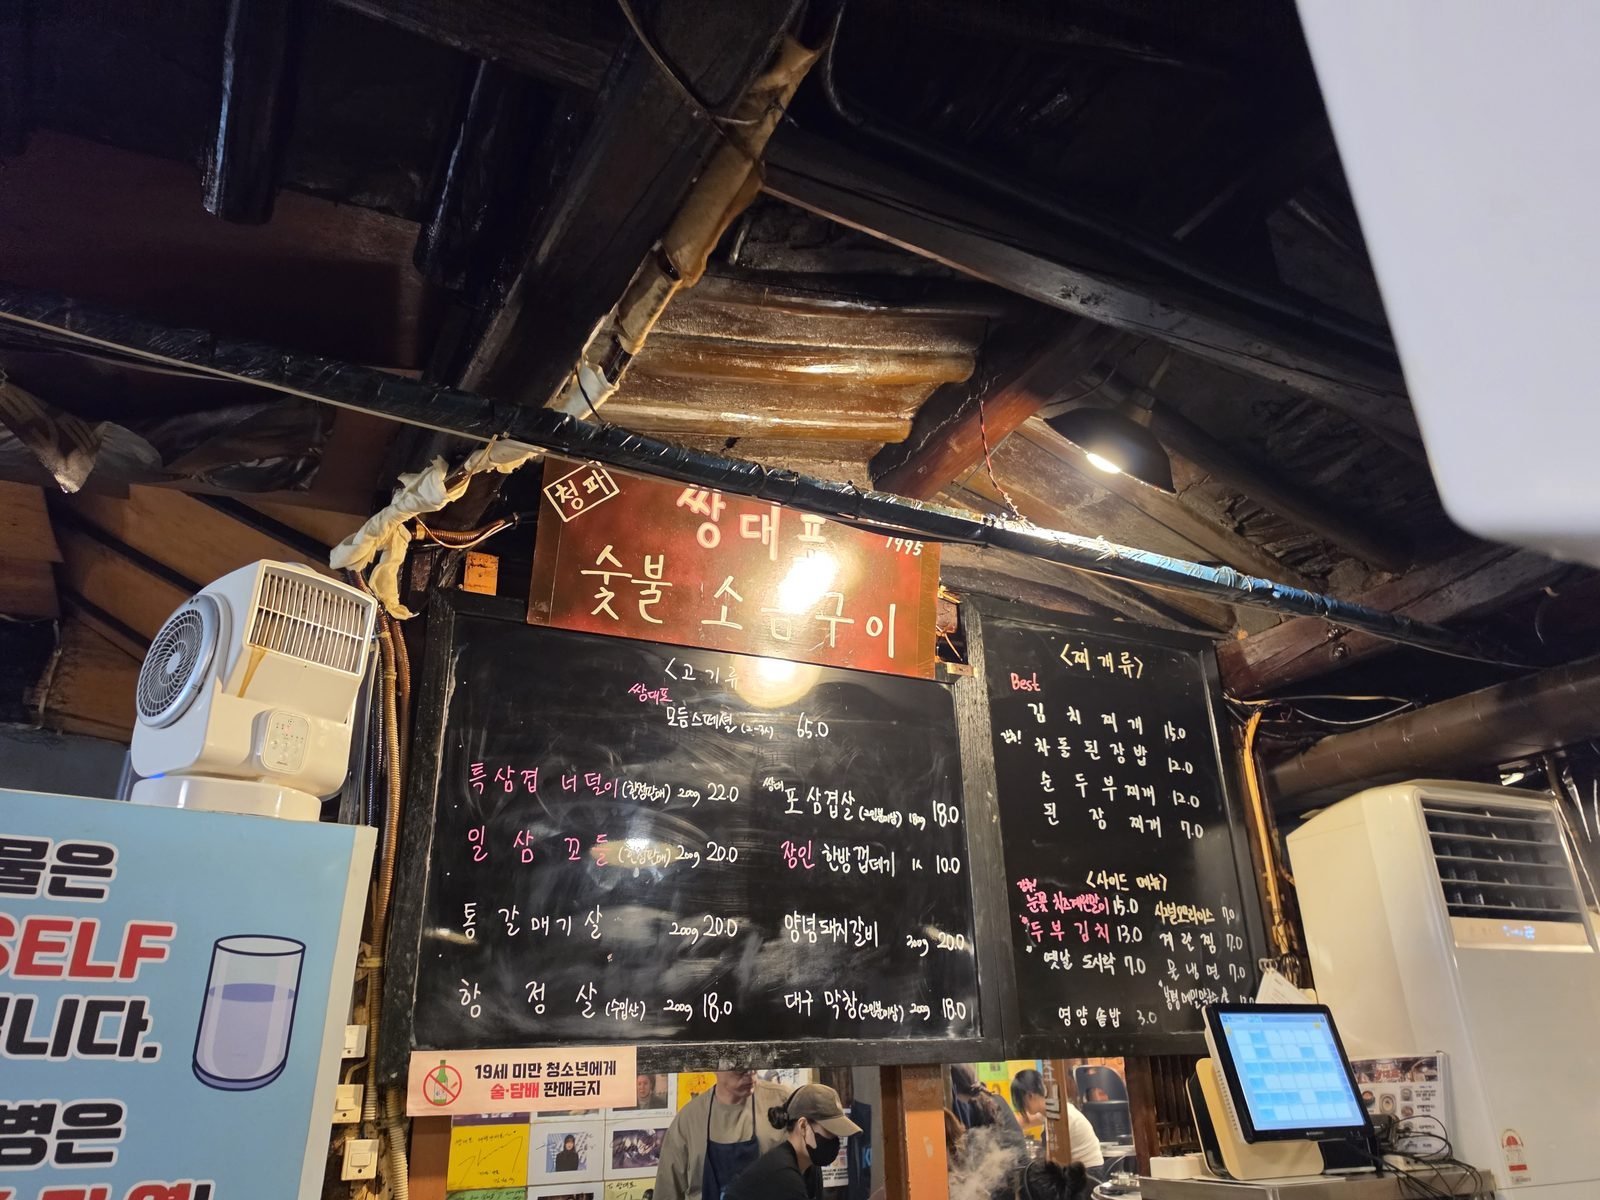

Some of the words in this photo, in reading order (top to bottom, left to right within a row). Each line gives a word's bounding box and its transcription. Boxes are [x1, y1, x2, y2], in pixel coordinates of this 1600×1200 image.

[554, 469, 607, 510] 청파
[885, 536, 923, 557] 1995
[581, 545, 673, 624] 숯불
[1010, 672, 1041, 692] Best
[797, 712, 829, 739] 65.0
[1163, 720, 1187, 741] 15.0
[1167, 757, 1194, 775] 12.0
[677, 787, 701, 808] 200g
[707, 782, 740, 803] 22.0
[1172, 790, 1200, 808] 12.0
[806, 786, 856, 821] 삼겹살
[933, 800, 960, 828] 18.0
[1180, 820, 1204, 839] 7.0
[675, 844, 701, 869] 200g
[706, 841, 739, 863] 20.0
[781, 839, 816, 870] 장인
[936, 854, 961, 874] 10.0
[0, 838, 115, 899] 물은
[1113, 894, 1139, 917] 15.0
[1222, 906, 1236, 926] 7.0
[668, 922, 699, 944] 200g
[703, 915, 738, 937] 20.0
[936, 931, 965, 951] 20.0
[1117, 923, 1143, 944] 13.0
[1226, 933, 1243, 952] 7.0
[1082, 951, 1117, 976] 도시락
[1124, 955, 1147, 976] 7.0
[1229, 963, 1246, 983] 7.0
[663, 998, 694, 1022] 200g
[703, 991, 733, 1023] 18.0
[784, 989, 815, 1017] 대구
[909, 1003, 931, 1021] 200g
[942, 997, 967, 1020] 18.0
[0, 998, 157, 1058] 니다.
[1136, 1009, 1158, 1027] 3.0
[474, 1063, 508, 1080] 19세
[512, 1062, 542, 1079] 미만
[546, 1060, 617, 1078] 청소년에게
[489, 1082, 540, 1100] 술·담배
[543, 1080, 601, 1098] 판매금지
[0, 1103, 123, 1166] 병은
